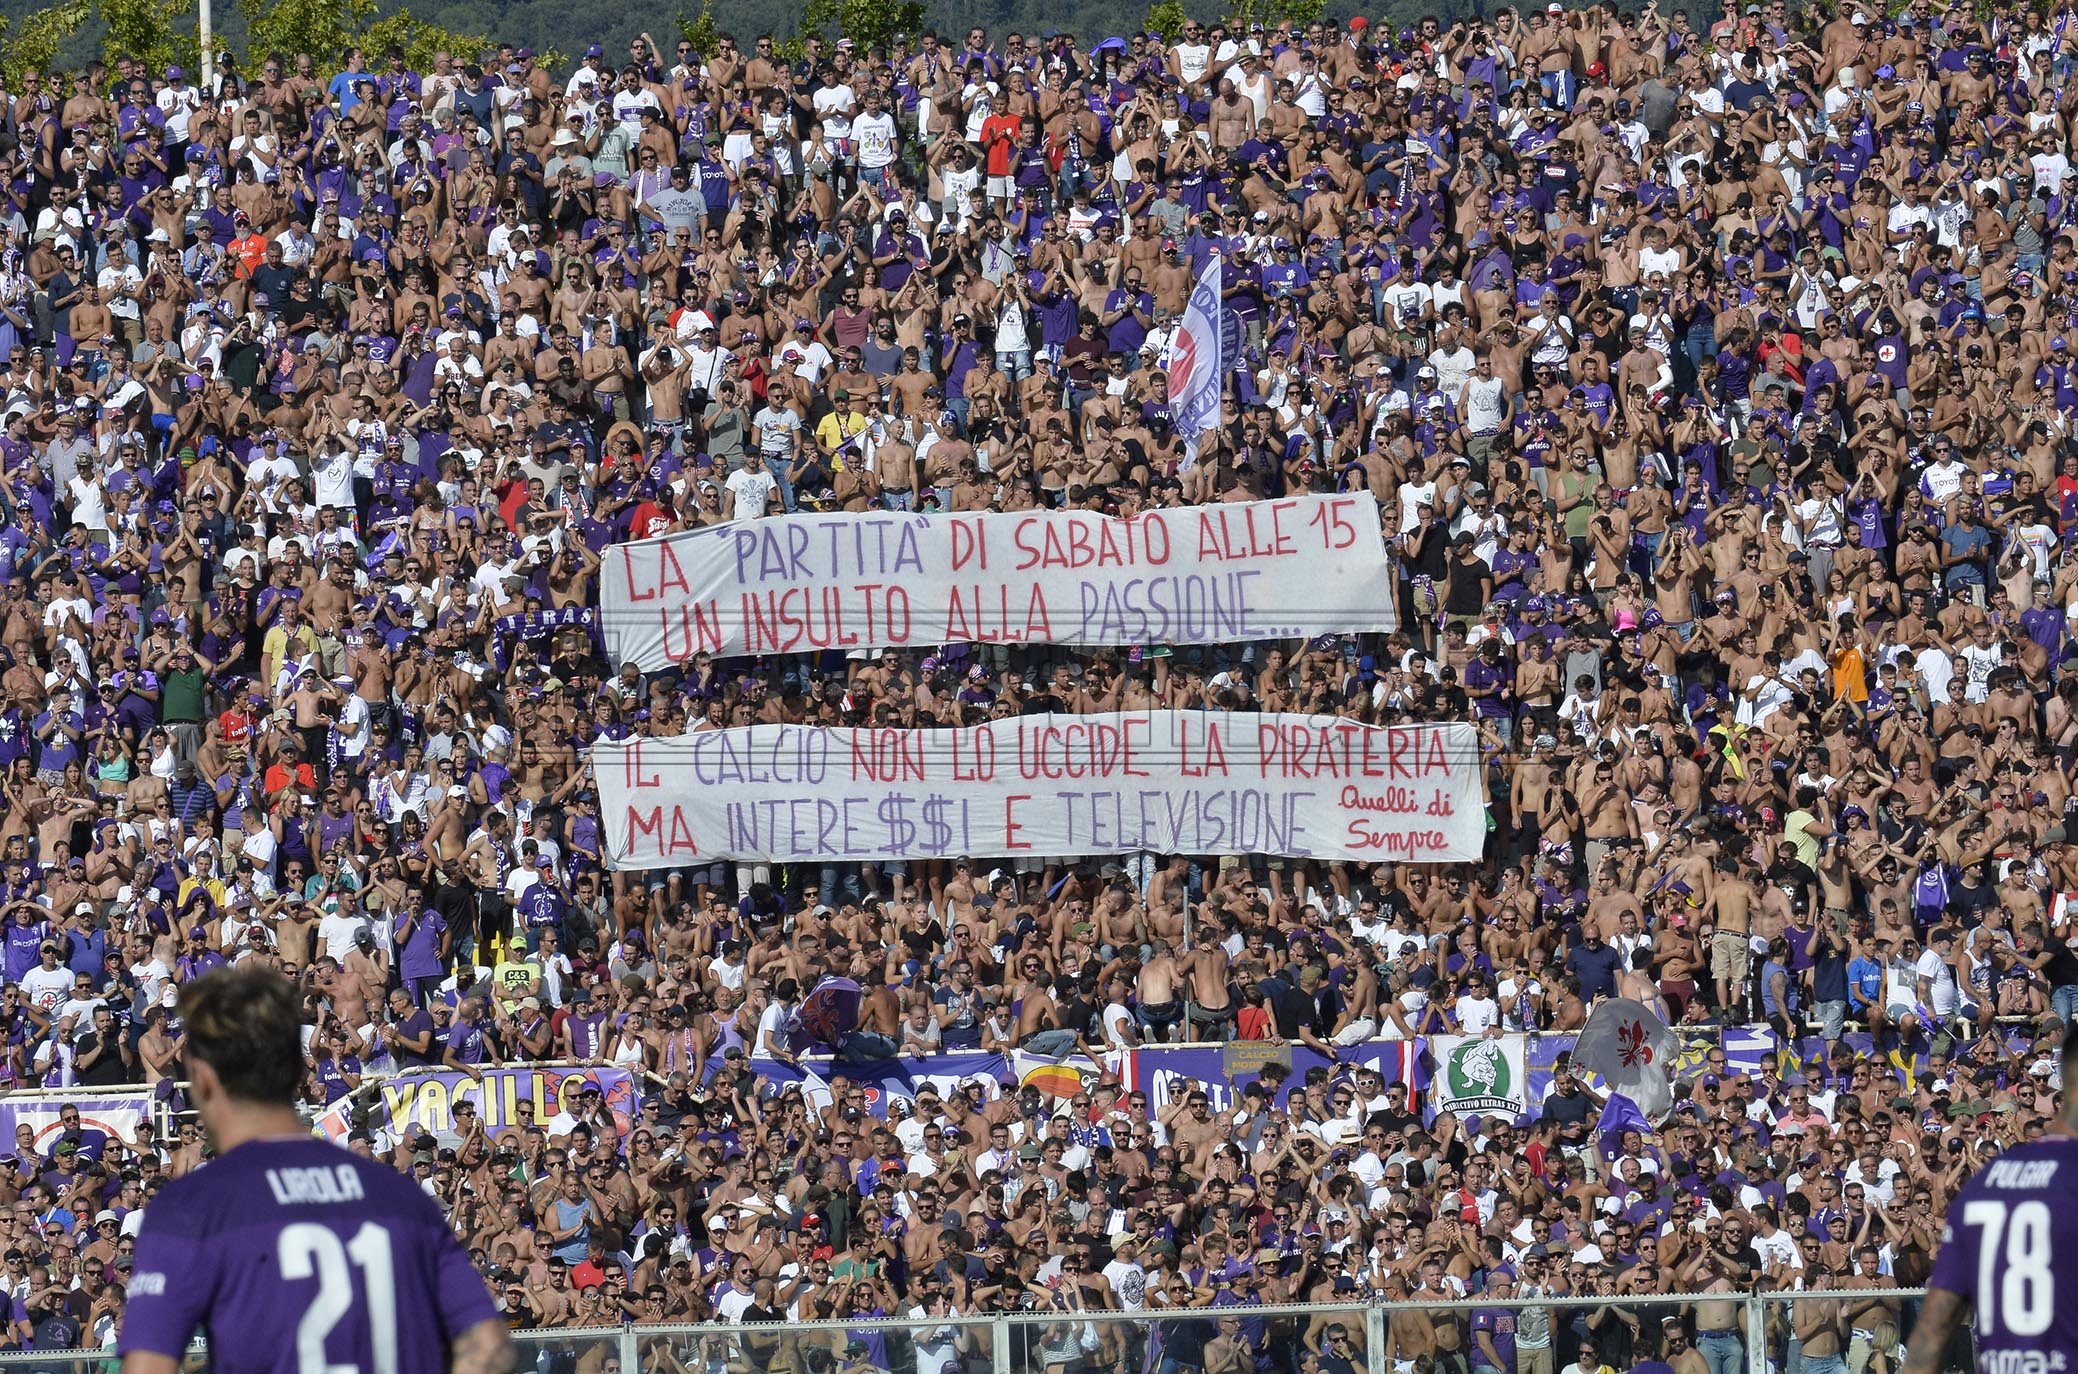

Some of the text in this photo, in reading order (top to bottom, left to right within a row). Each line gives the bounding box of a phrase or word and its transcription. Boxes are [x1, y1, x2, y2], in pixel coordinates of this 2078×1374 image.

[1936, 478, 1960, 487] TOYOT
[624, 540, 689, 601] LA
[950, 517, 987, 571] DI
[1014, 512, 1170, 570] SABATO
[1198, 501, 1298, 562] ALLE
[1309, 500, 1357, 549] 15
[661, 570, 1301, 661] UN INSULTO ALLA PASSIONE...
[625, 718, 1450, 788] IL CALCIO NON LO UCCIDE LA PIRATERIA
[1338, 784, 1455, 817] Quelli di
[627, 788, 1316, 857] MA INTERE$$I E TELEVISIONE
[1344, 818, 1449, 860] Sempre
[508, 971, 527, 981] C&S
[1444, 1100, 1480, 1112] DIRECTIVO
[1480, 1099, 1505, 1109] ULTRAS
[265, 1163, 366, 1206] LIROLA
[1984, 1159, 2060, 1189] PULGAR
[1963, 1200, 2055, 1337] 78
[276, 1221, 399, 1374] 21
